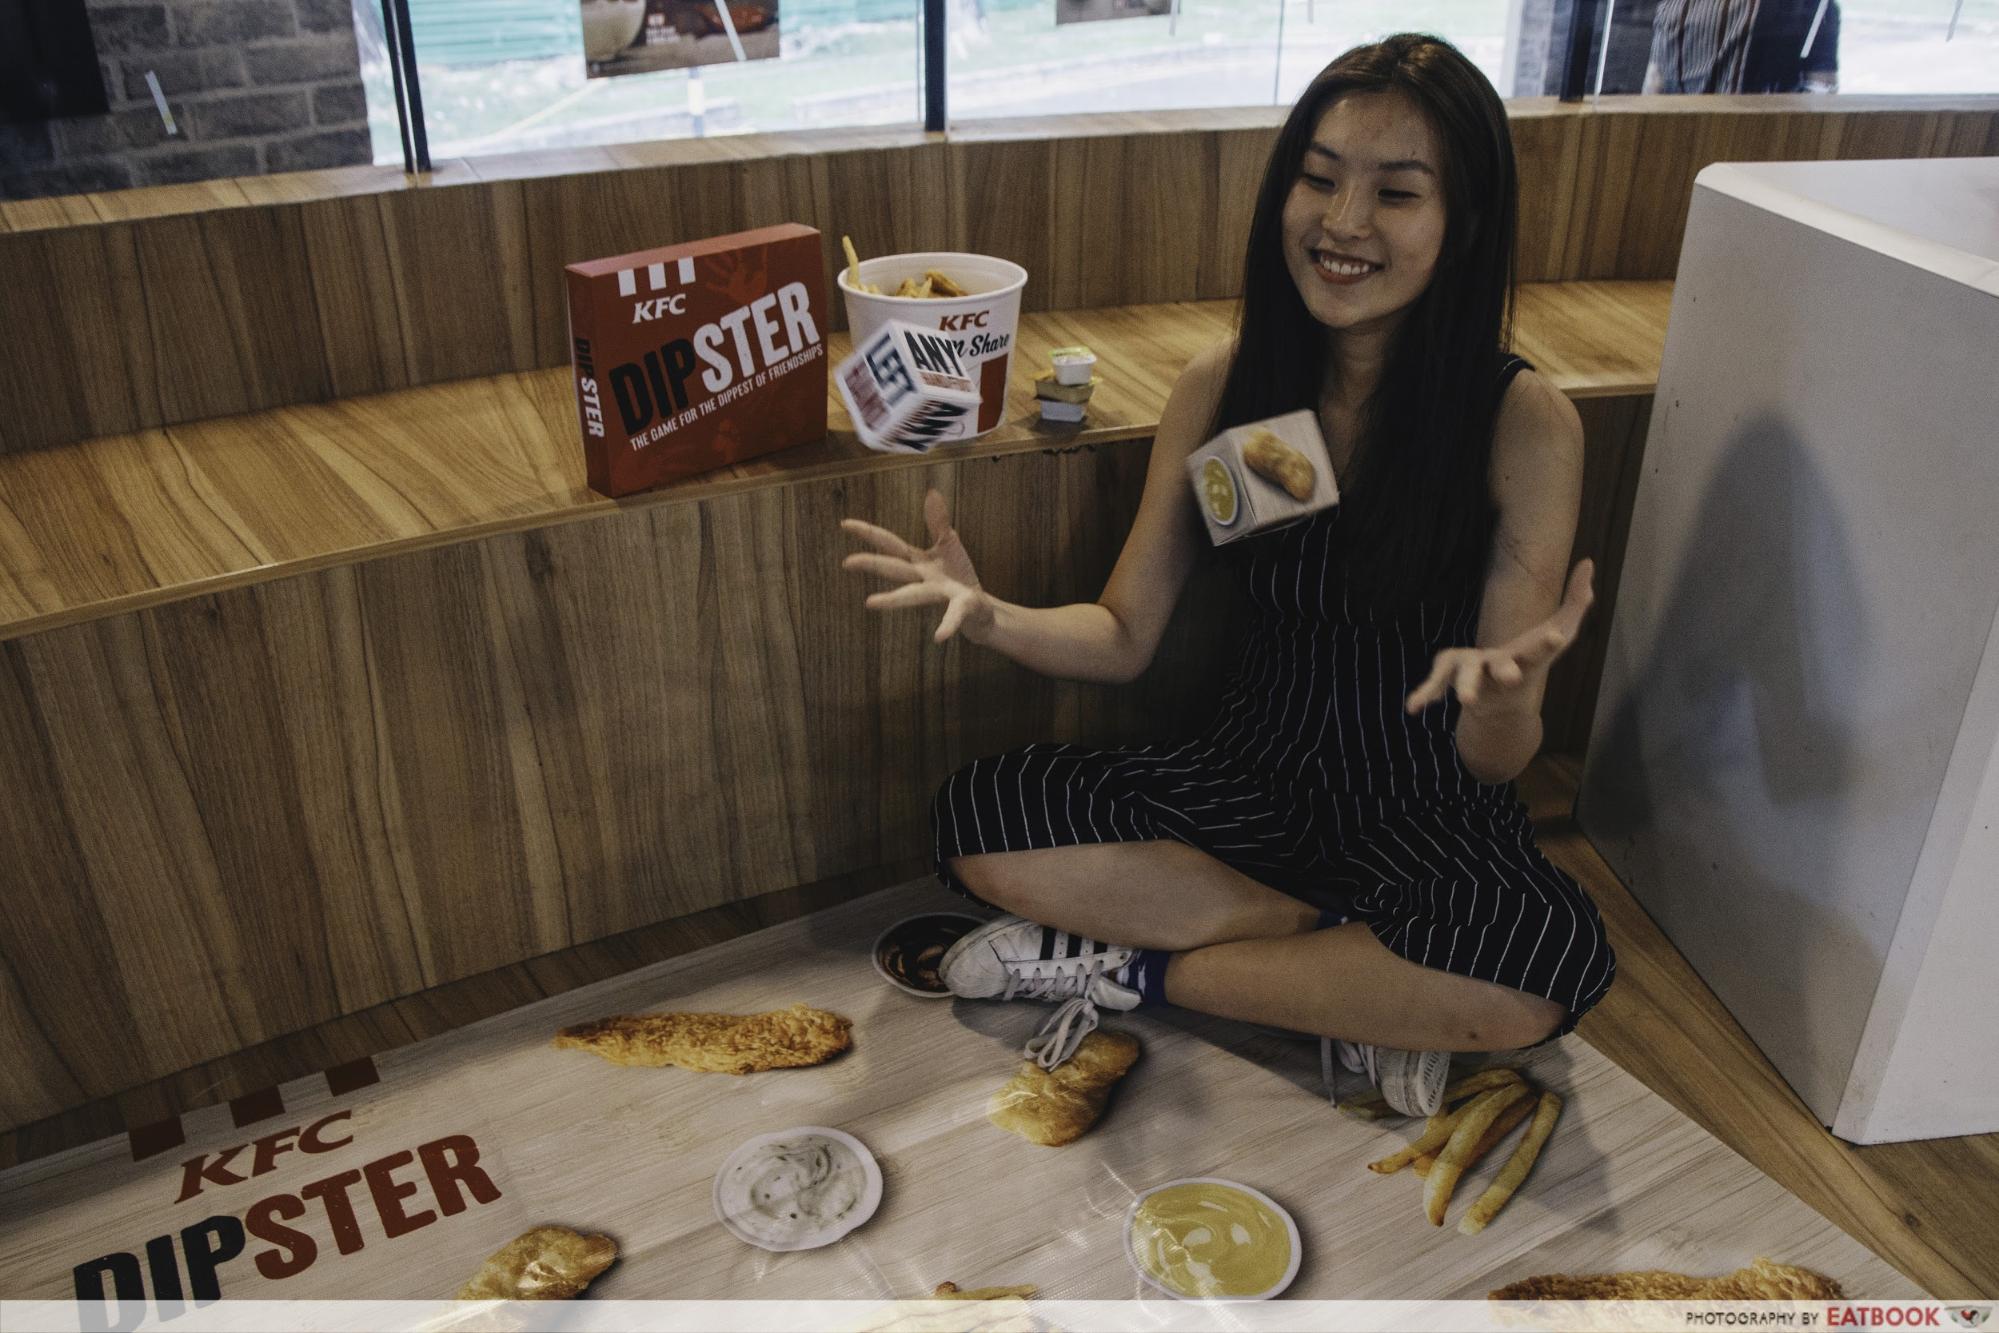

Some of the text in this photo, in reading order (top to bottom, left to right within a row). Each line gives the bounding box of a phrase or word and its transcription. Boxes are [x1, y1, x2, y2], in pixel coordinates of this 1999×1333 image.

[632, 294, 687, 325] KFC
[939, 310, 990, 332] KFC
[969, 332, 1010, 357] Share
[608, 281, 821, 436] DIPSTER
[865, 332, 917, 409] LEFT
[903, 329, 964, 378] ANY
[630, 343, 824, 452] THE GAME FOR THE DIPPEST OF FRIENDSHIPS
[173, 1109, 355, 1205] KFC
[73, 1133, 502, 1333] DIPSTER
